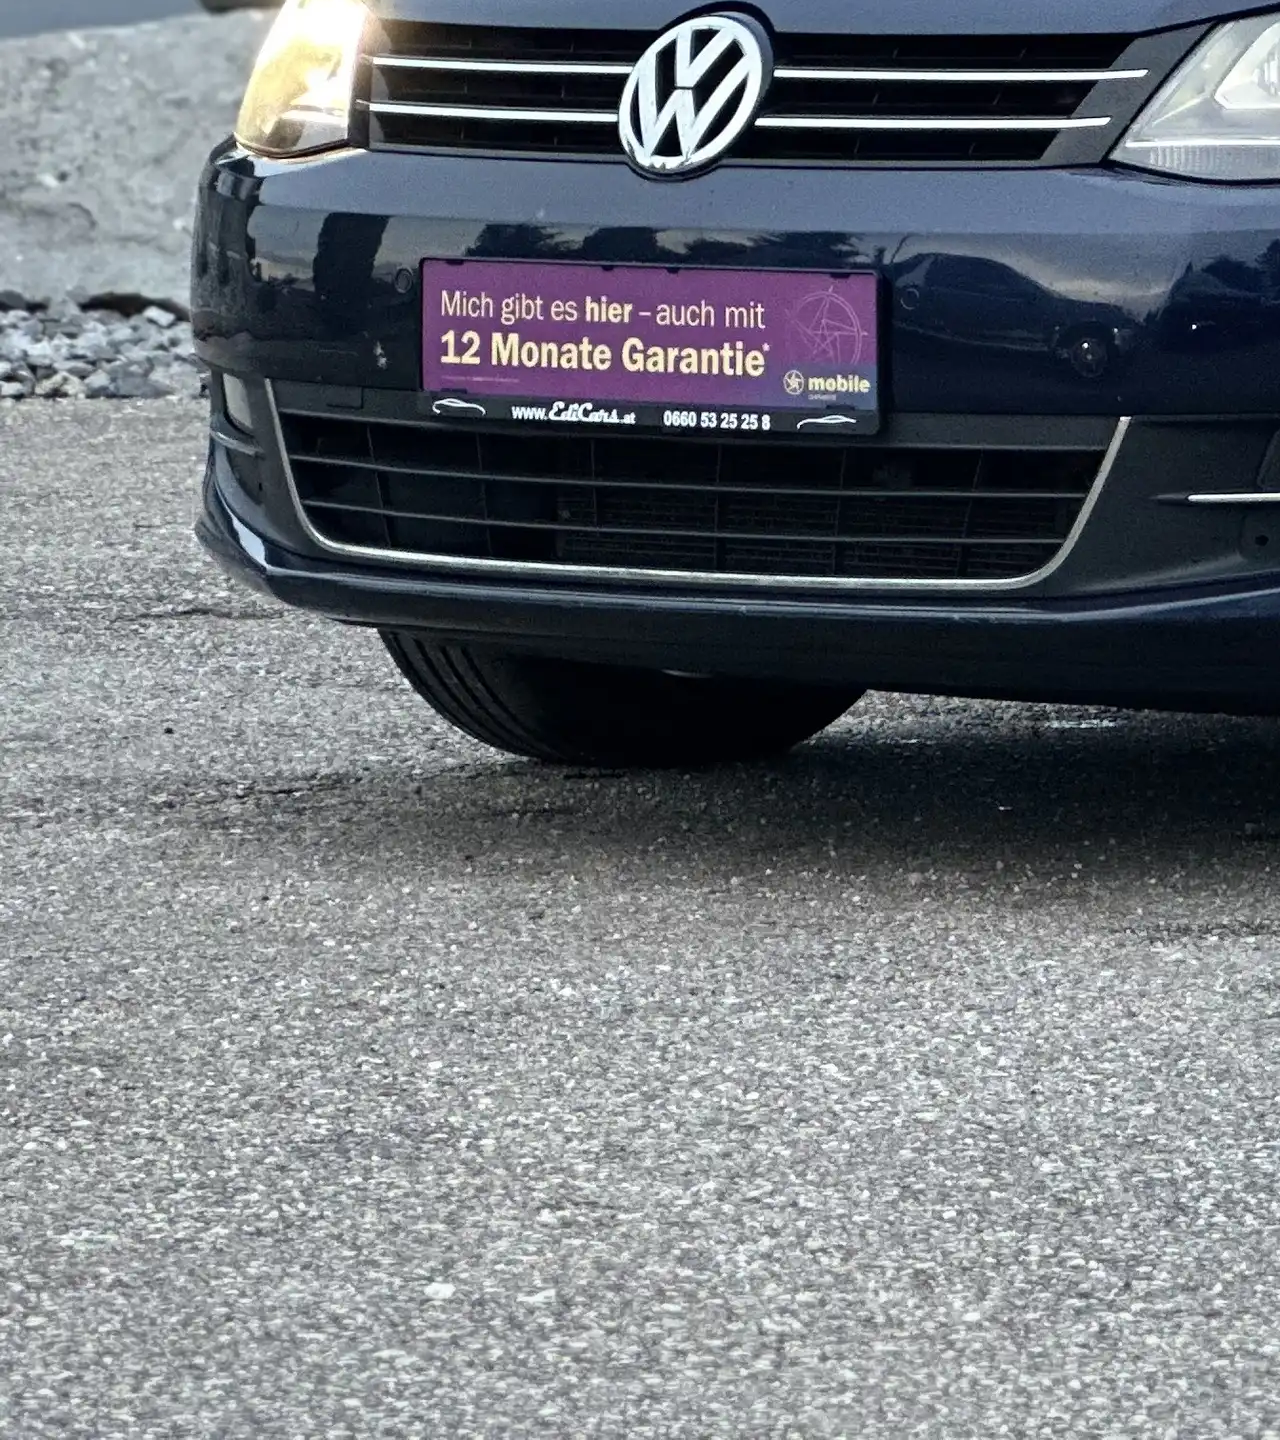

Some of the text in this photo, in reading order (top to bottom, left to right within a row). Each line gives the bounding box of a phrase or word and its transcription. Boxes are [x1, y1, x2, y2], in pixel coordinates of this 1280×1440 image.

[440, 289, 494, 318] Mich
[500, 292, 545, 326] gibt
[550, 300, 578, 322] es
[585, 295, 634, 323] hier
[656, 299, 716, 327] auch
[725, 300, 766, 330] mit
[440, 329, 481, 365] 12
[491, 332, 613, 371] Monate
[808, 374, 871, 394] mobile
[511, 401, 771, 431] www.EdiCars.at 0660 53 25 25 8
